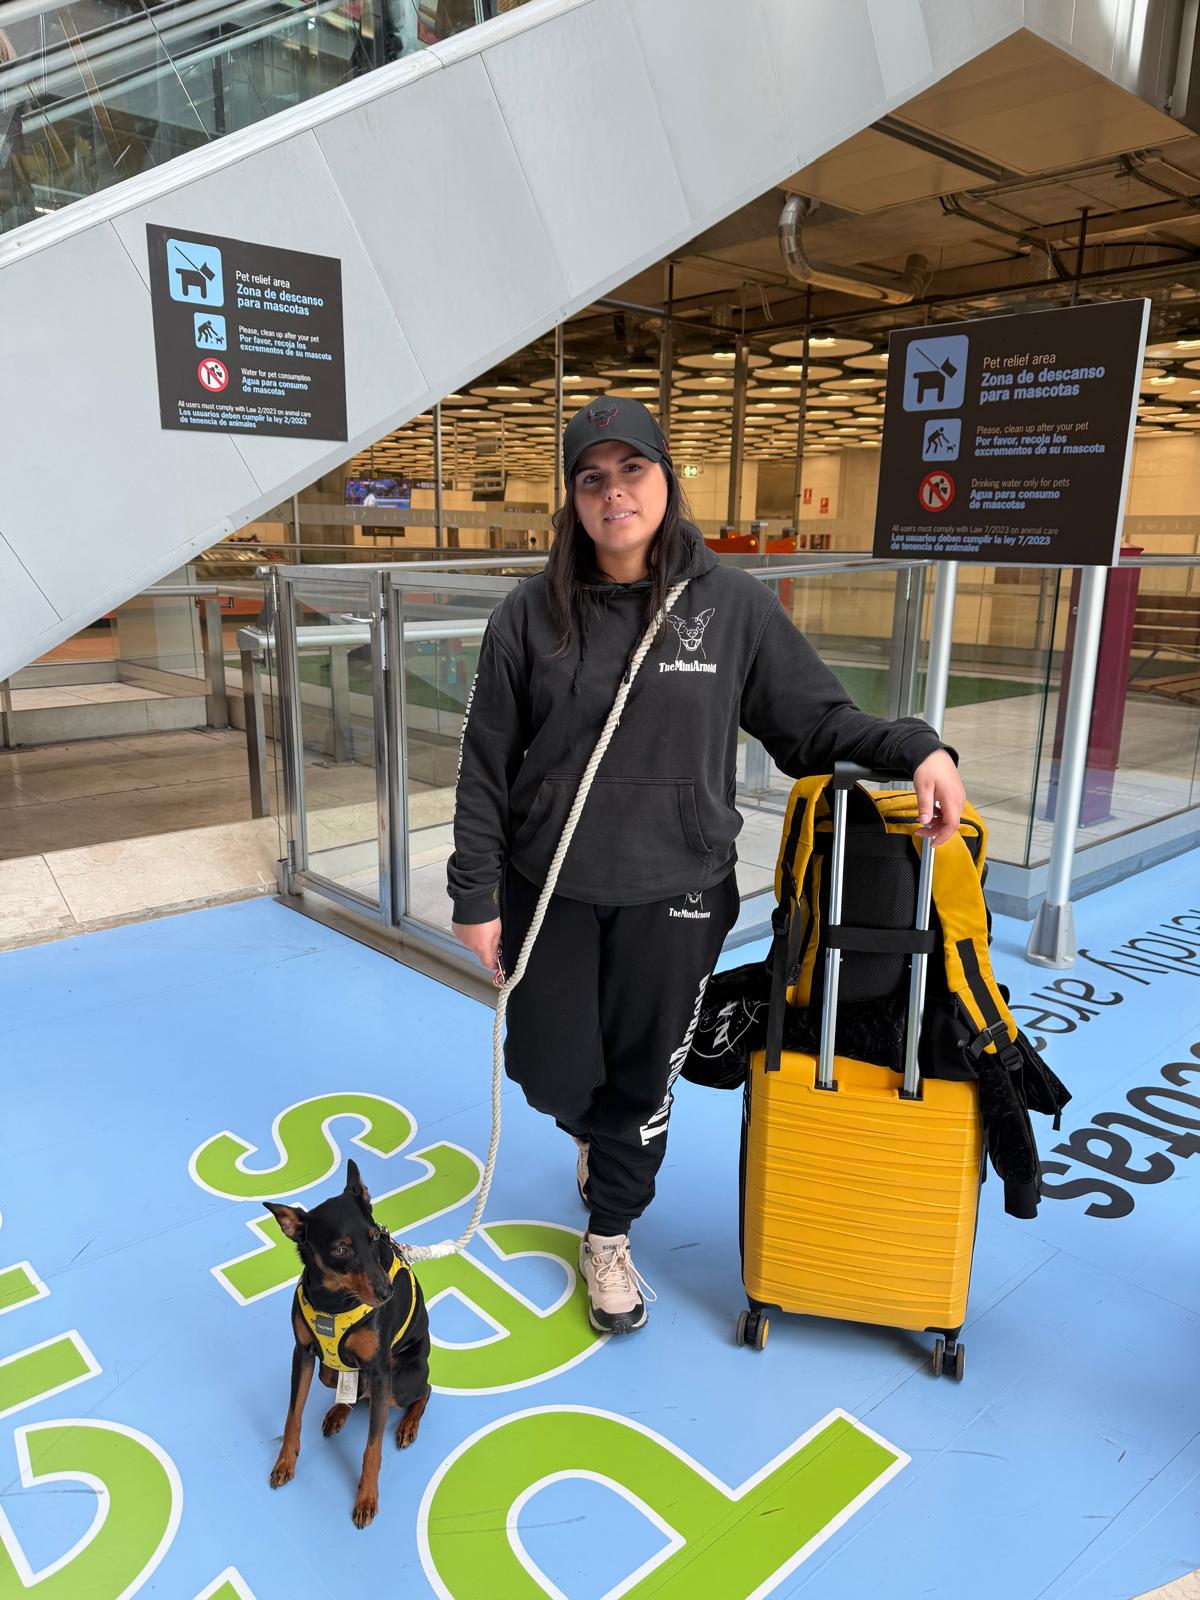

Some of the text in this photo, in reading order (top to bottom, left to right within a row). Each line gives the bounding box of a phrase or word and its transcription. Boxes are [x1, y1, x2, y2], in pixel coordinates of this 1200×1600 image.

[235, 270, 290, 289] Pet relief area
[236, 283, 324, 306] Zona de descanso
[237, 297, 310, 316] para mascotas
[239, 325, 259, 336] Please,
[284, 332, 296, 340] after
[297, 334, 309, 342] your
[239, 334, 307, 350] Por favor, recoja los
[240, 343, 284, 355] excrementos
[285, 348, 294, 356] de
[304, 351, 332, 360] mascota
[983, 353, 1057, 369] Pet relief area
[241, 367, 311, 382] Water for pet consumption
[981, 366, 1105, 387] Zona de descanso
[242, 376, 308, 390] Agua para consumo
[242, 384, 286, 396] de mascotas
[979, 383, 1080, 405] para mascotas
[179, 407, 191, 416] Los
[192, 410, 220, 418] usuarios
[221, 411, 241, 419] deben
[241, 414, 265, 422] cumplir
[273, 415, 283, 425] ley
[284, 416, 307, 425] 2/2023
[189, 417, 218, 425] tenencia
[228, 420, 256, 428] animales
[976, 421, 1089, 435] Please, clean up after your pet
[975, 433, 1068, 447] Por favor, recoja los
[974, 443, 1105, 456] excrementos de su mascota
[971, 477, 1070, 488] Drinking water only for pets
[969, 489, 1060, 501] Agua para consumo
[969, 500, 1026, 509] de mascotas
[890, 541, 980, 552] de tenencia de animales
[891, 533, 1051, 546] Los usuarios deben cumplir la ley 7/2023
[659, 660, 717, 673] TheMiniArnold
